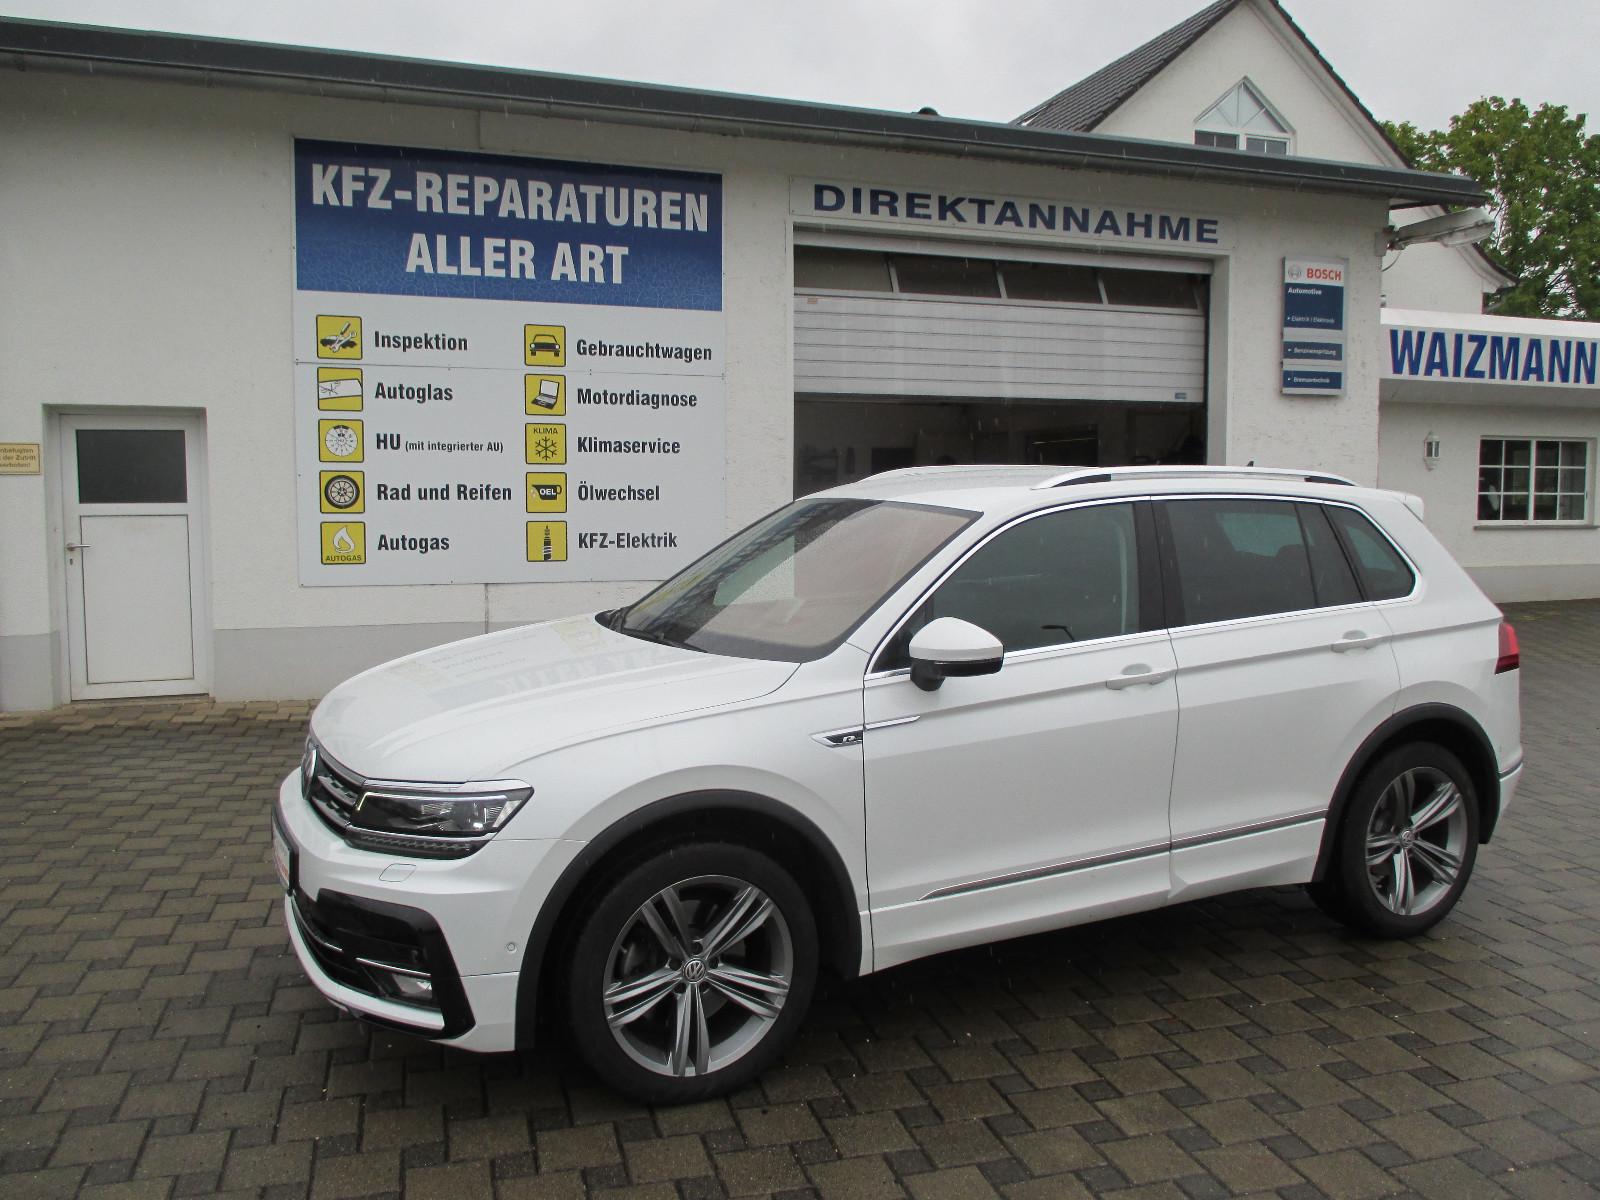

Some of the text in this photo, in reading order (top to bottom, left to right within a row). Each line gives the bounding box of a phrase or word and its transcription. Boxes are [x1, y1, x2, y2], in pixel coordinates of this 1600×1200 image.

[311, 163, 708, 233] KFZ-REPARATUREN
[813, 183, 1219, 244] DIREKTANNAHME
[405, 233, 629, 285] ALLER ART
[1306, 268, 1342, 281] BOSCH
[1287, 287, 1322, 295] Automotive
[374, 330, 468, 351] Inspektion
[576, 339, 712, 363] Gebrauchtwagen
[1389, 329, 1598, 385] WAIZMANN
[374, 382, 453, 403] Autoglas
[577, 388, 697, 409] Motordiagnose
[533, 427, 558, 435] KLIMA
[376, 433, 504, 453] HU (mit integrierter AU)
[577, 437, 681, 454] Klimaservice
[376, 483, 512, 501] Rad und Reifen
[539, 488, 557, 496] OEL
[578, 481, 660, 501] Ölwechsel
[377, 534, 450, 553] Autogas
[578, 532, 678, 549] KFZ-Elektrik
[325, 554, 362, 562] AUTOGAS
